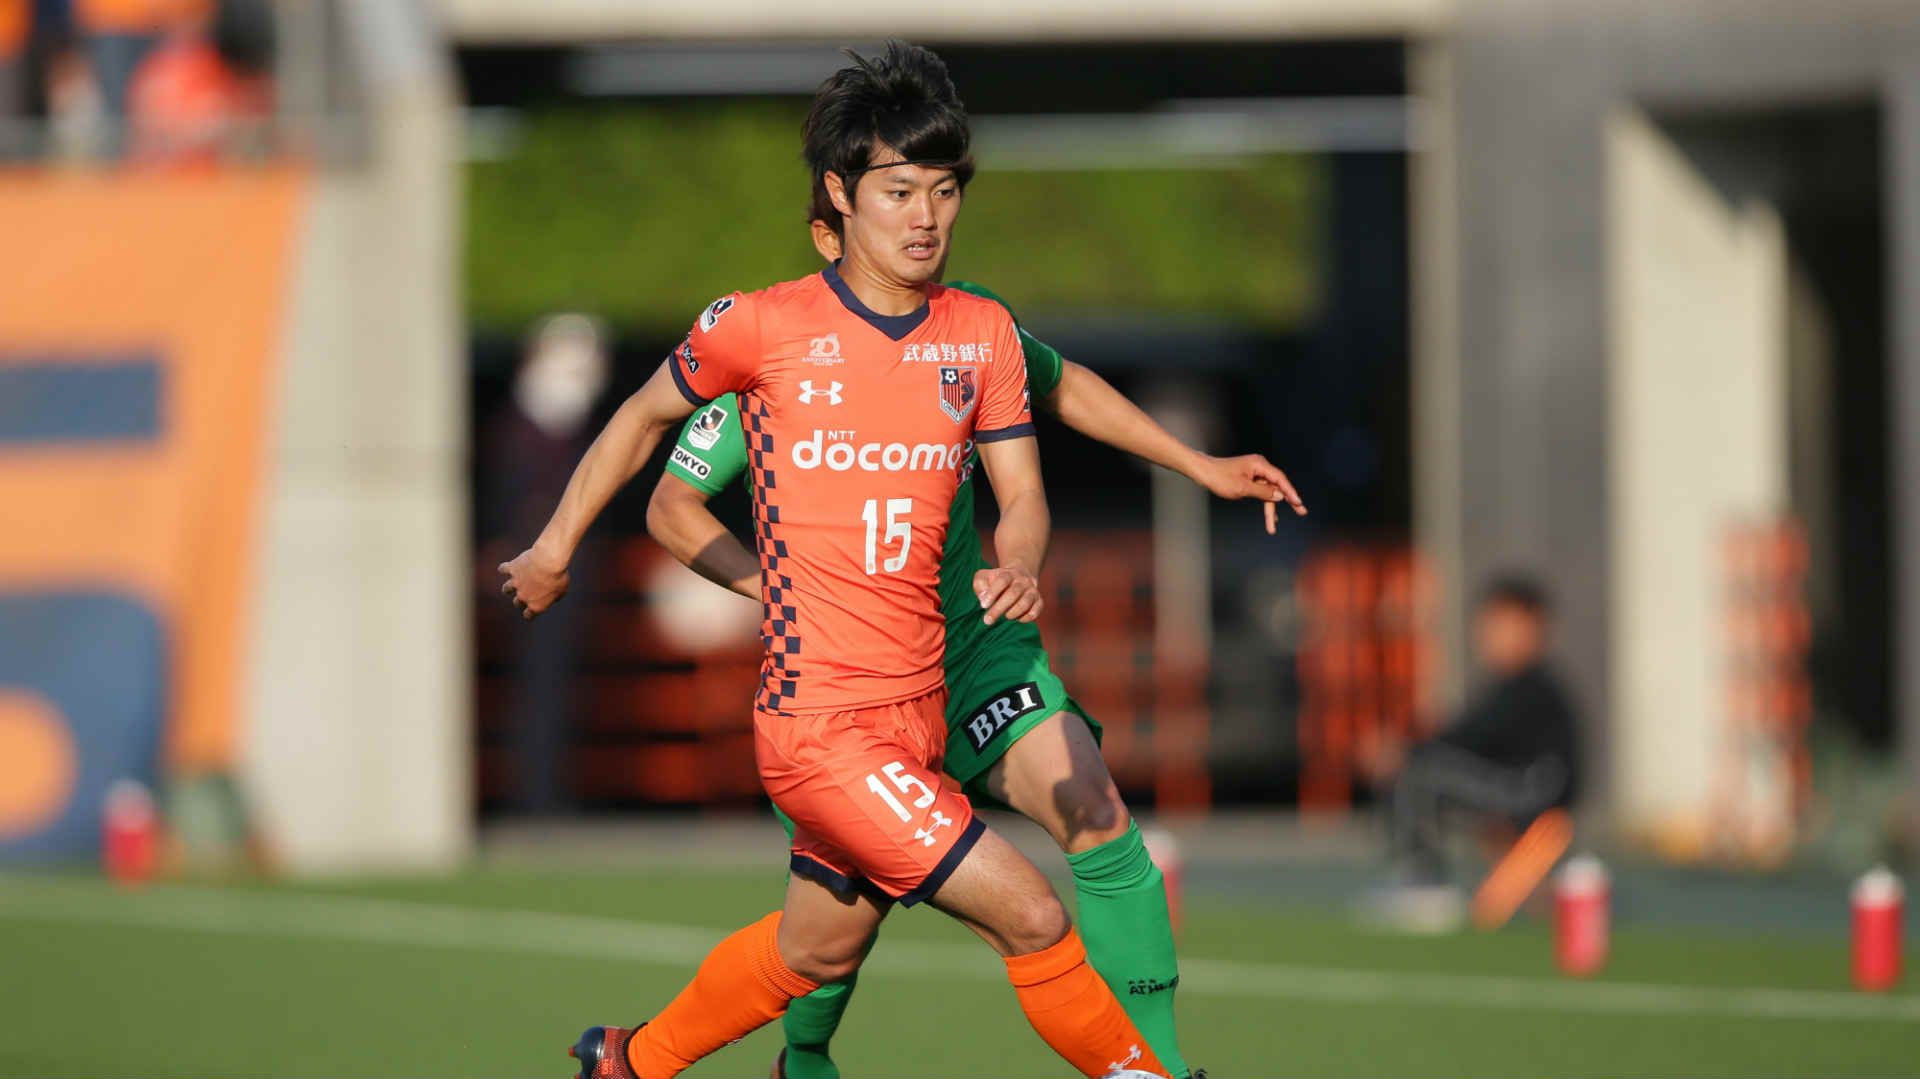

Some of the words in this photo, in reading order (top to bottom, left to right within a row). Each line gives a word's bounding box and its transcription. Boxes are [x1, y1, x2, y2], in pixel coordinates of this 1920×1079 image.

[903, 343, 993, 362] 武蔵野銀行
[792, 429, 962, 471] docomo
[828, 430, 856, 440] NTT
[862, 498, 913, 575] 15
[968, 687, 1037, 748] BRI
[865, 761, 935, 823] 15
